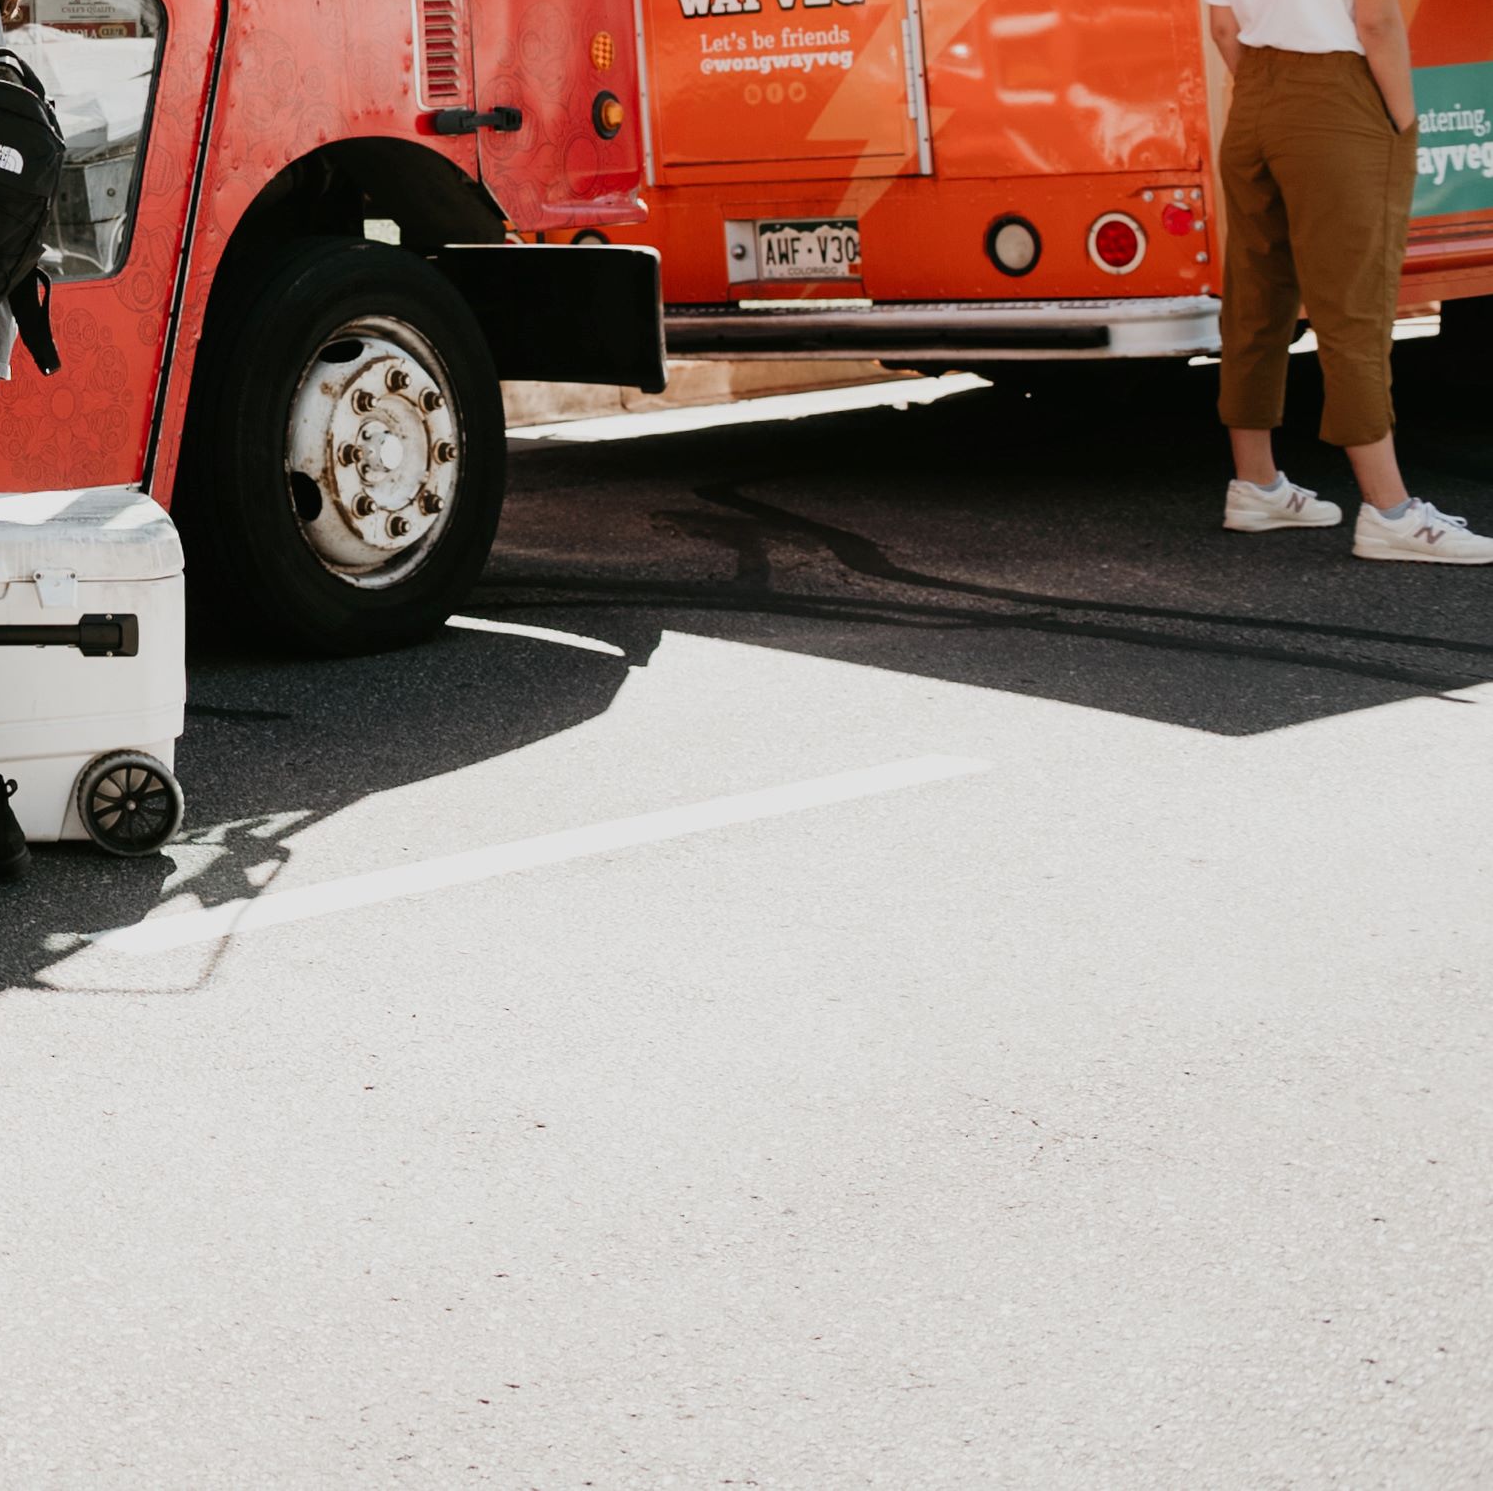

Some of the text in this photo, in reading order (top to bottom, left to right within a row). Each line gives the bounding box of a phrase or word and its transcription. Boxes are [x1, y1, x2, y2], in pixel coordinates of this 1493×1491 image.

[700, 25, 850, 54] Let's be friends
[700, 50, 853, 74] @wongwayveg
[1418, 103, 1491, 137] atering,
[1417, 142, 1493, 185] ayveg
[788, 267, 838, 276] COLORADO
